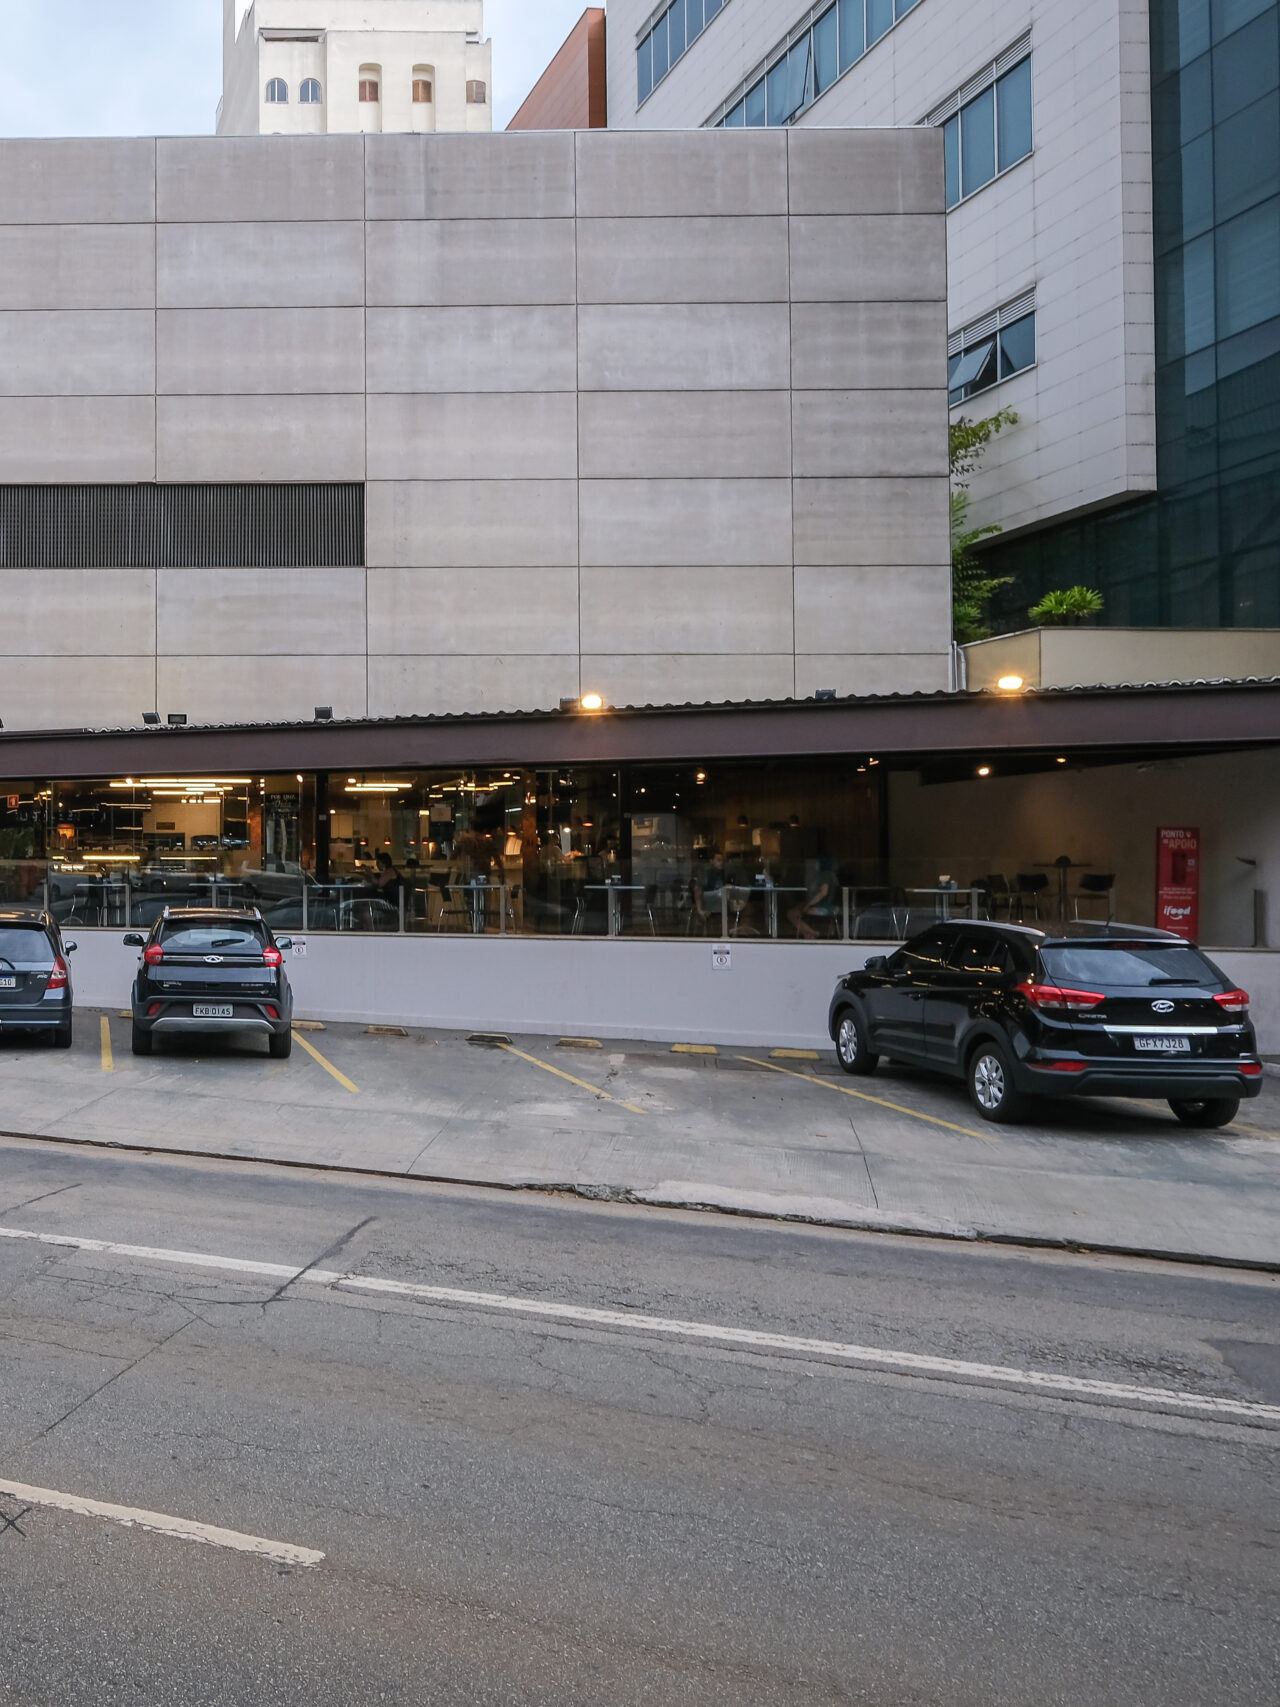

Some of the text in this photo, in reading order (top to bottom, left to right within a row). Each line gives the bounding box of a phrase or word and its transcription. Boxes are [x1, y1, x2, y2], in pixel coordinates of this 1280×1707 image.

[1161, 829, 1184, 838] PONTO
[1168, 839, 1196, 849] APOIO
[1139, 1037, 1184, 1049] GFX7J28
